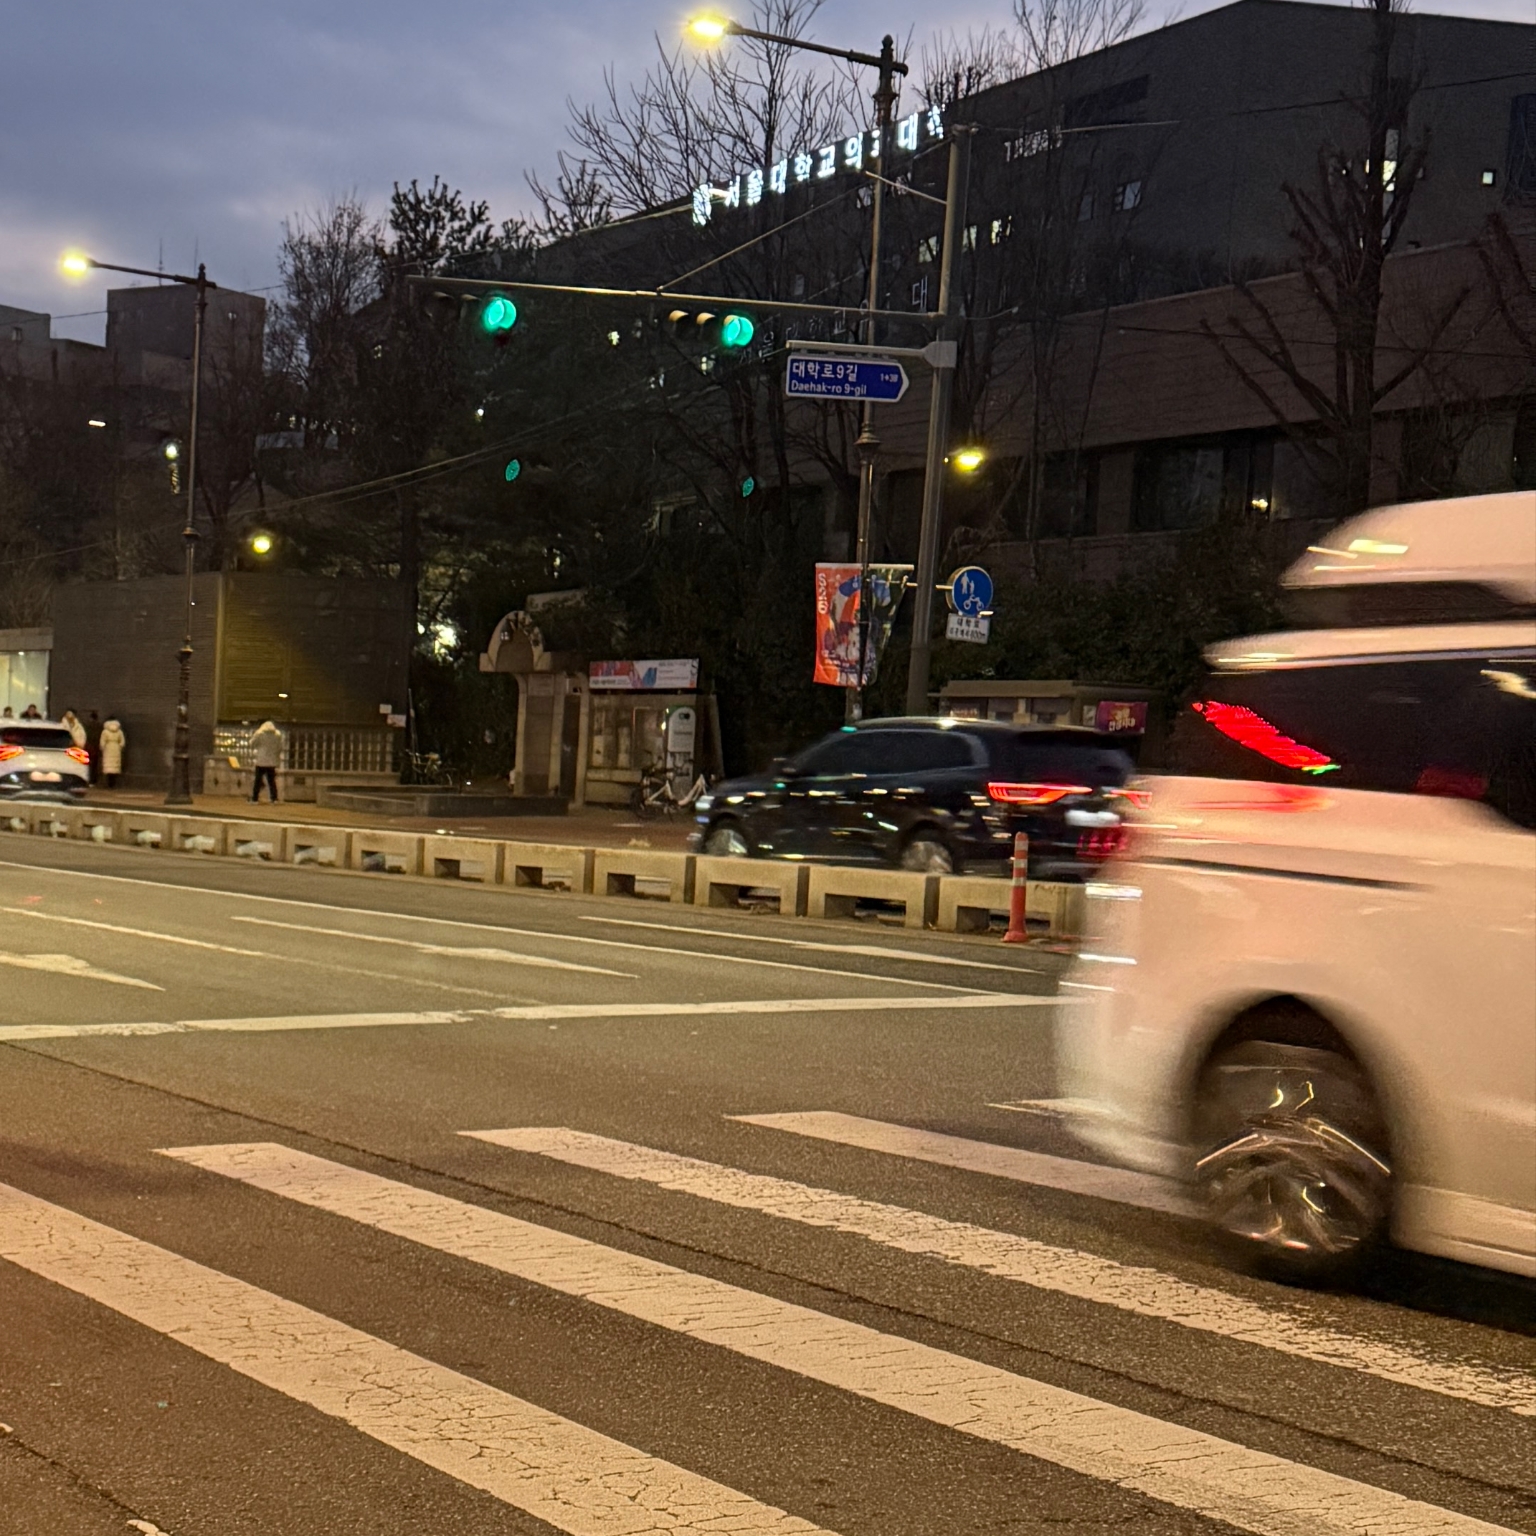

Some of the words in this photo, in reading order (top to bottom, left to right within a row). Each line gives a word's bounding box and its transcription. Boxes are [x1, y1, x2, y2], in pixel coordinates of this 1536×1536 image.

[792, 361, 858, 382] 대학로9길
[791, 379, 842, 394] Daehak-ro
[844, 383, 867, 397] 9-gil
